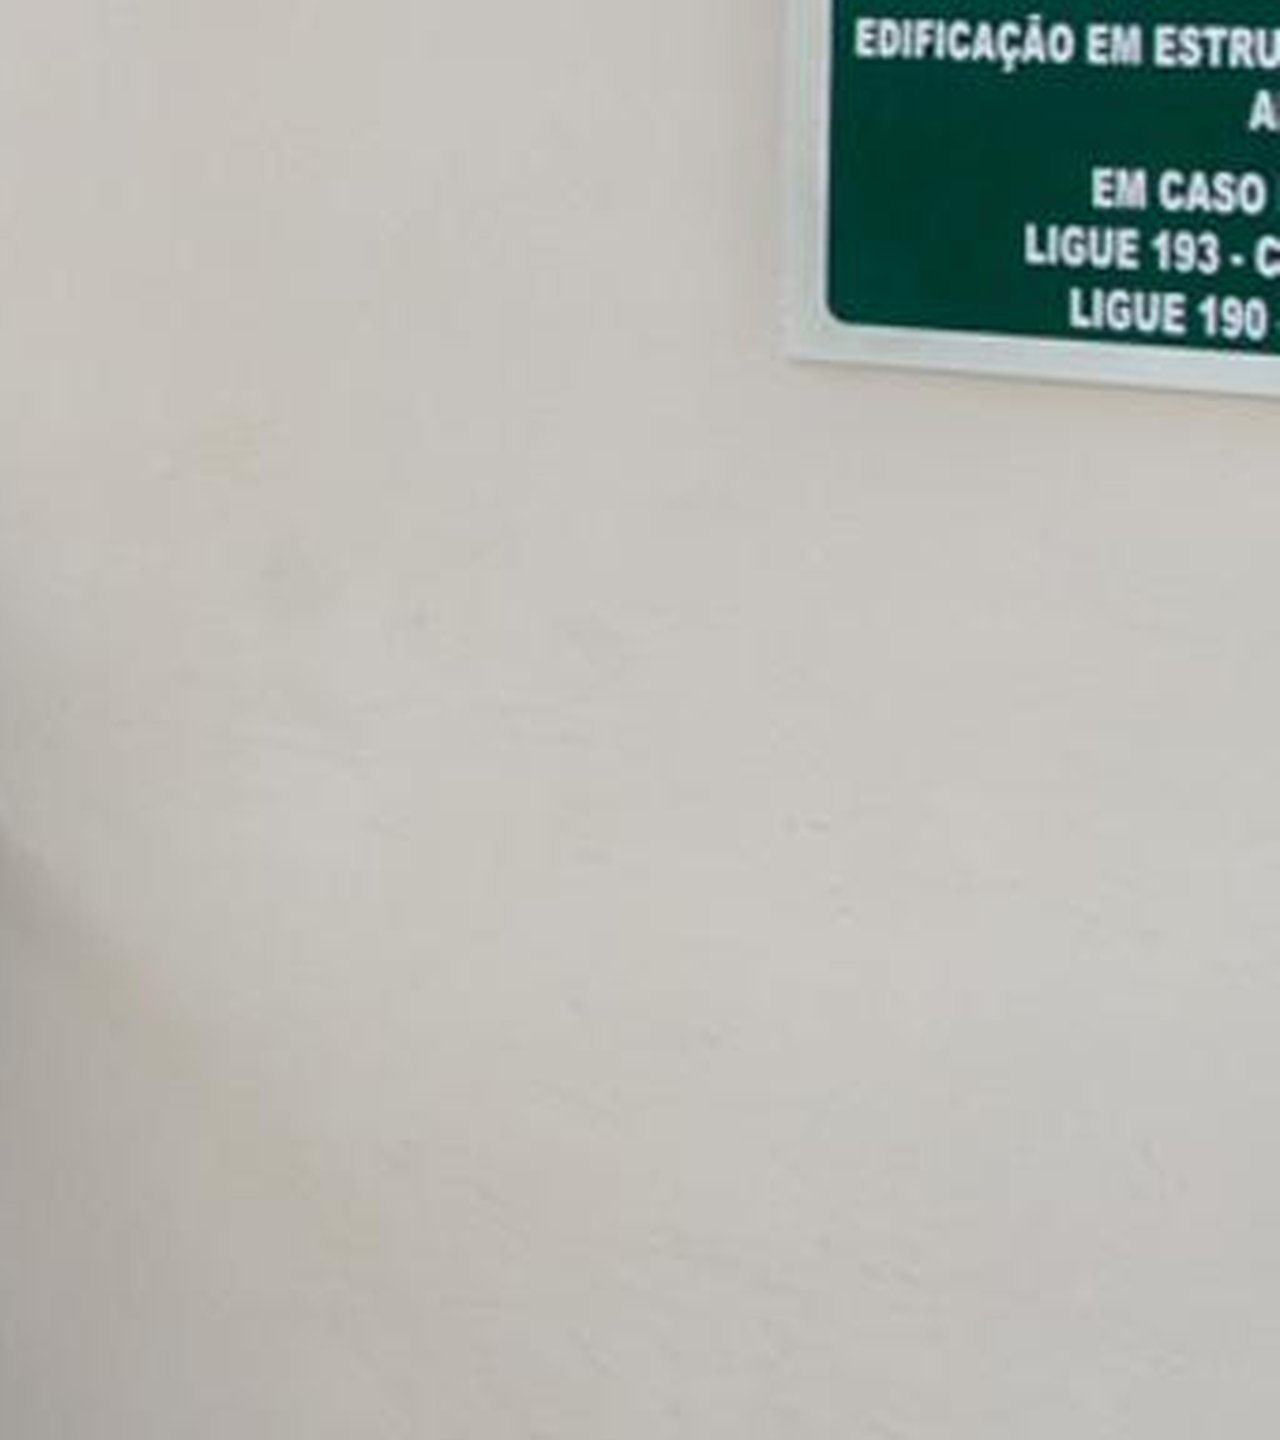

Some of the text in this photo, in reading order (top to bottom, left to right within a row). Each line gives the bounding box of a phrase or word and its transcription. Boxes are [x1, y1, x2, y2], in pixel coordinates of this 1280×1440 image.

[855, 13, 1280, 73] EDIFICAÇÃO EM ESTRU
[1092, 167, 1267, 215] EM CASO
[1025, 224, 1139, 270] LIGUE
[1152, 230, 1221, 275] 193
[1070, 287, 1268, 341] LIGUE 190
